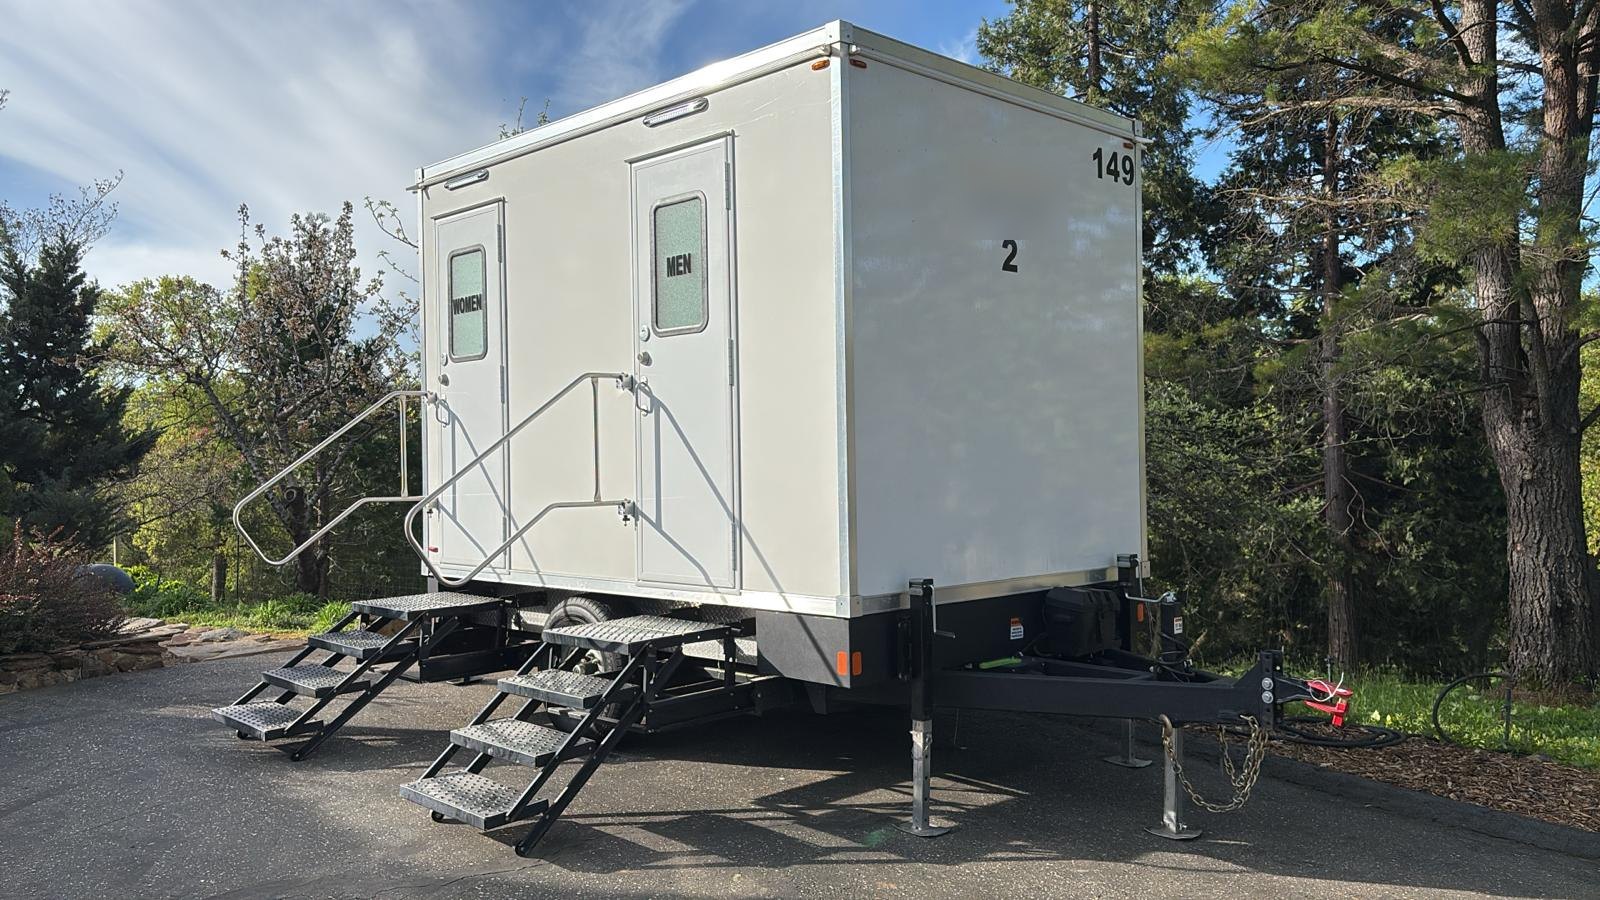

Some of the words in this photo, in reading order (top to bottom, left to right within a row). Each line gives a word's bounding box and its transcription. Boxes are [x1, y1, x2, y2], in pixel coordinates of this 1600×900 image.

[1092, 147, 1135, 186] 149
[666, 253, 692, 278] MEN
[1001, 240, 1018, 273] 2
[452, 293, 482, 315] WOMEN
